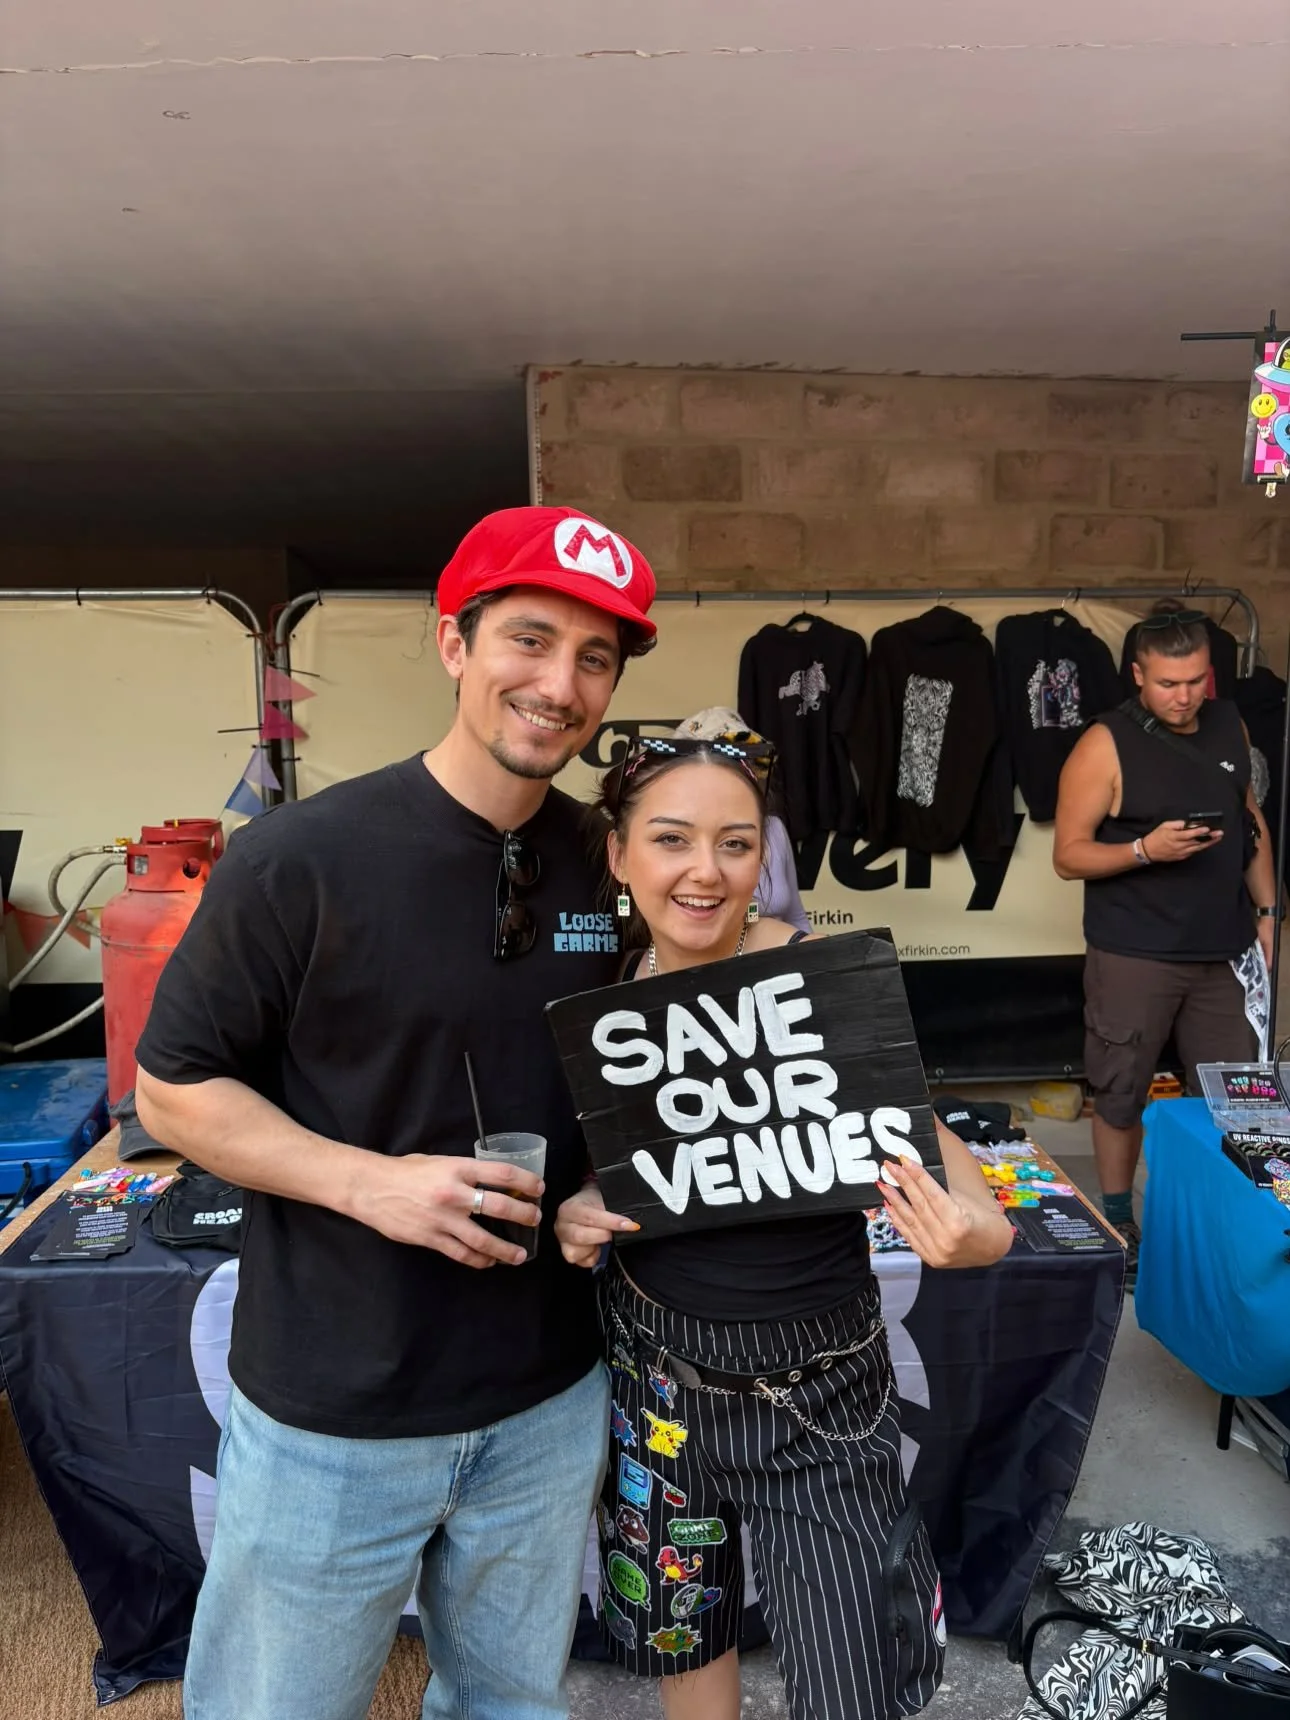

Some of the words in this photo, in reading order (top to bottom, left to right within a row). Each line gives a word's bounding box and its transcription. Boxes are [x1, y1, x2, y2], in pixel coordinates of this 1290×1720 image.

[564, 524, 627, 577] M
[554, 933, 618, 952] GARMS
[559, 912, 614, 931] LOOSE
[592, 972, 824, 1086] SAVE
[656, 1059, 838, 1133] OUR
[632, 1107, 923, 1215] VENUES
